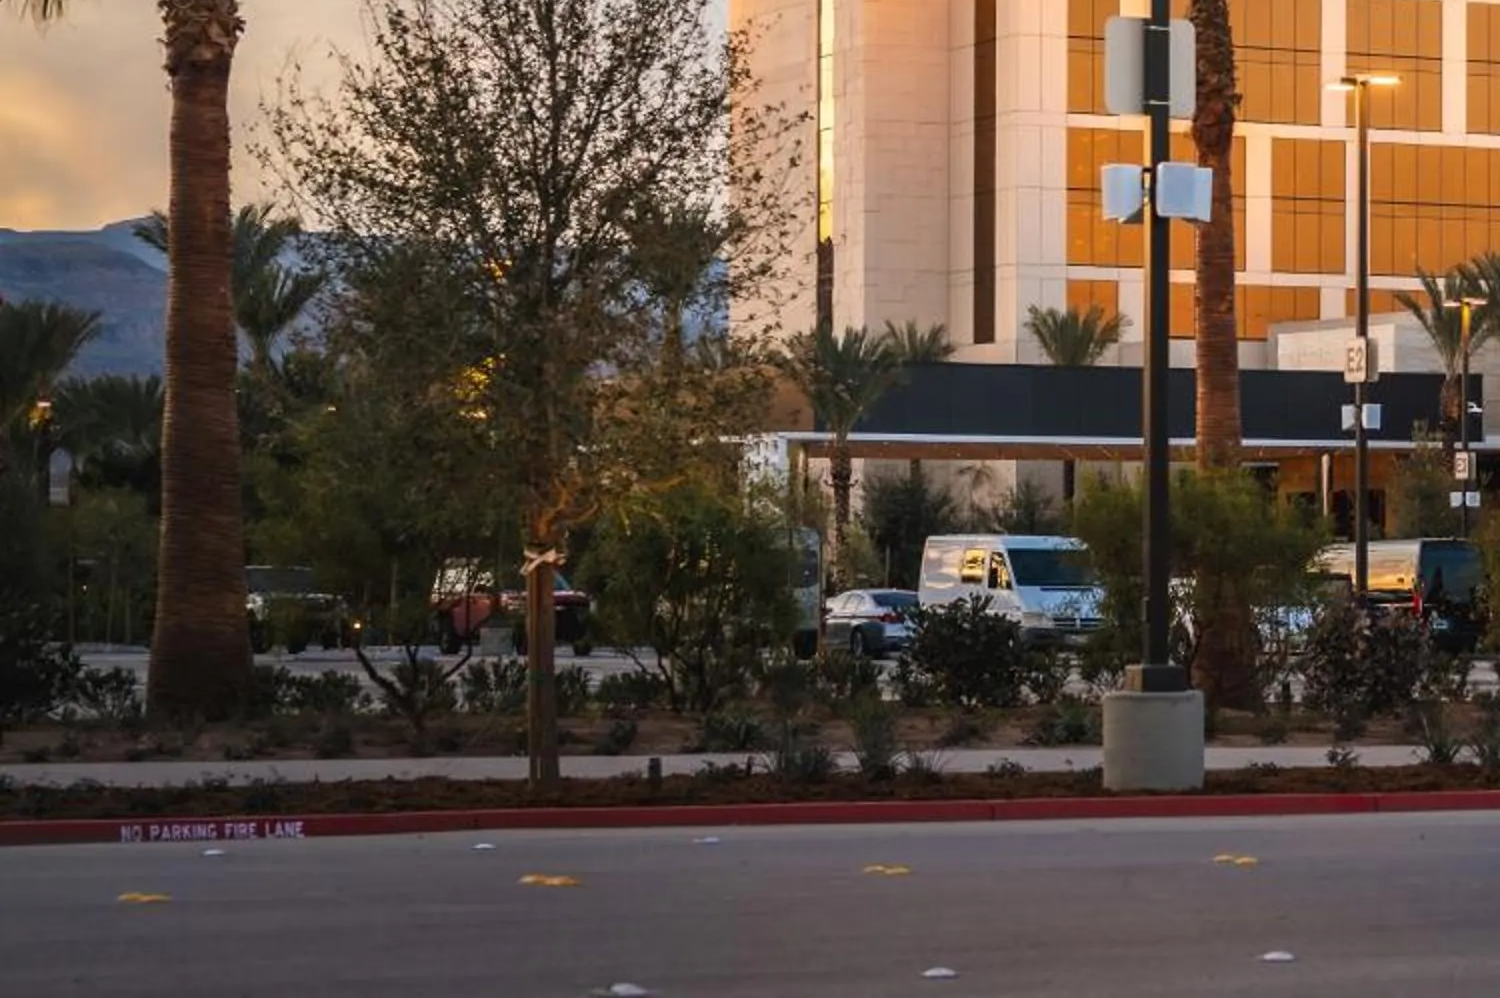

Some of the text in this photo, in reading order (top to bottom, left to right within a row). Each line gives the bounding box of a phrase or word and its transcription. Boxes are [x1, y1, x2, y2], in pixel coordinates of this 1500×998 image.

[120, 820, 305, 843] NO PARKING FIRE LANE
